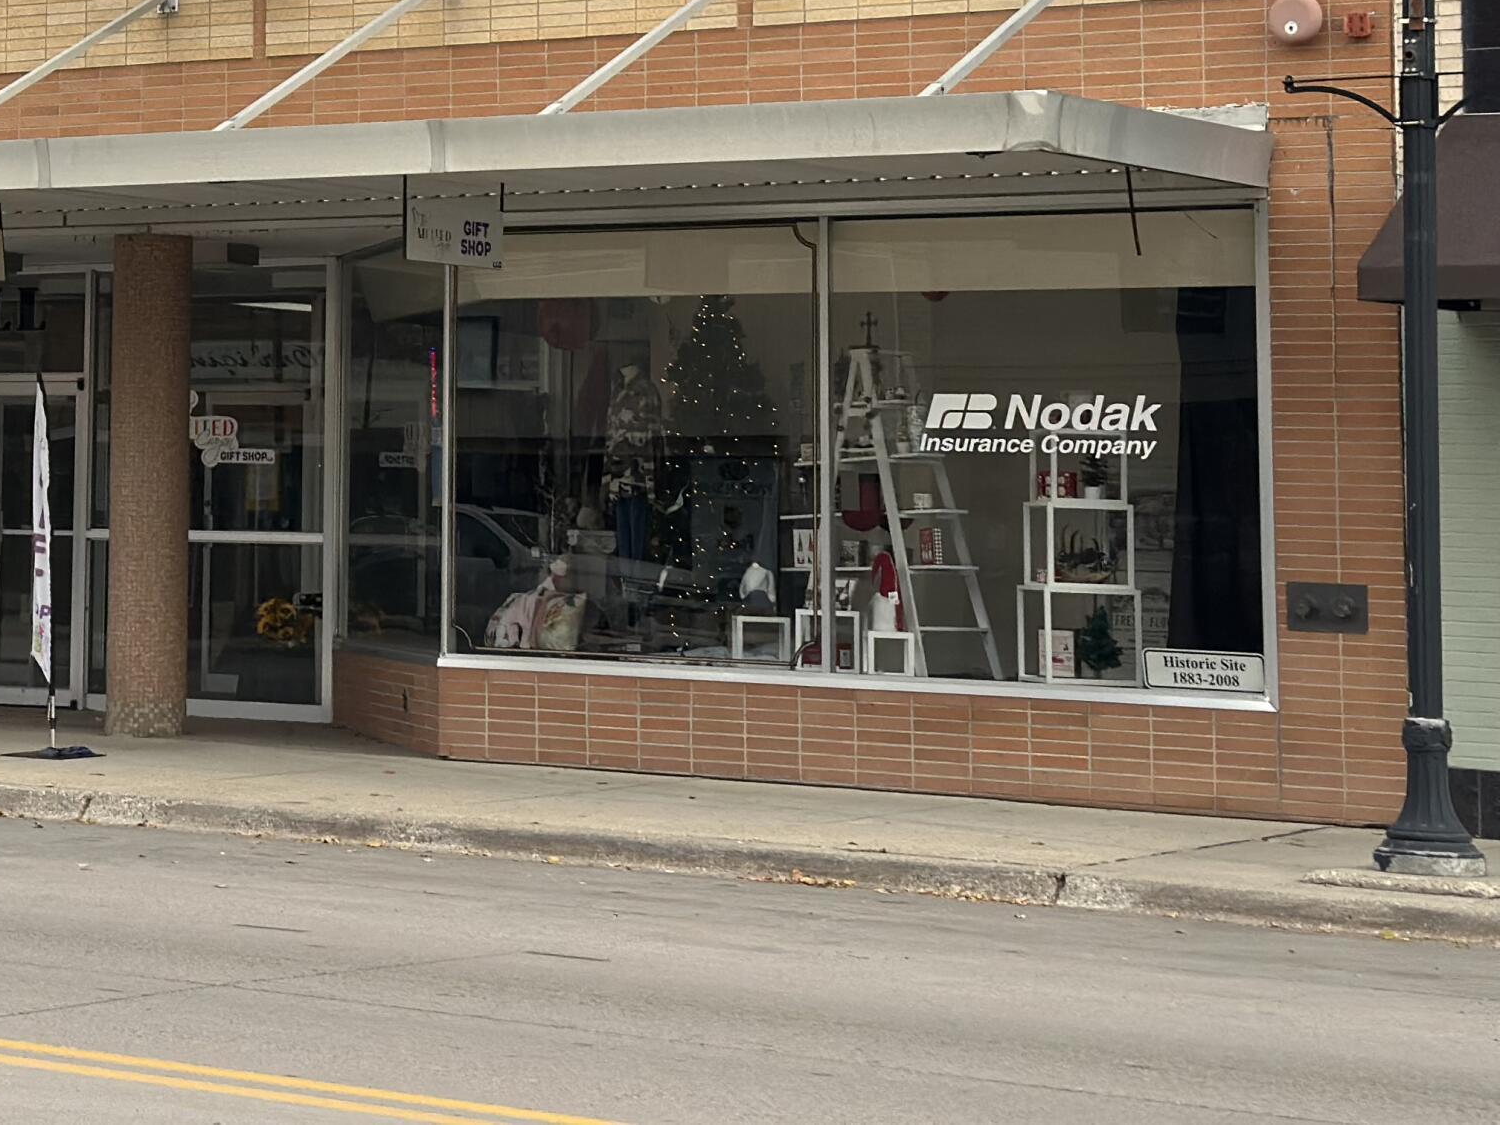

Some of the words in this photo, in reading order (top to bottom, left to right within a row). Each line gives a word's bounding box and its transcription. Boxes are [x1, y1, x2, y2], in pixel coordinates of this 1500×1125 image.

[463, 220, 489, 239] GIFT
[460, 239, 492, 256] SHOP
[1004, 394, 1162, 431] Nodak
[919, 433, 1034, 453] Insurance
[1041, 434, 1157, 460] Company
[220, 451, 240, 461] GIFT
[242, 451, 267, 461] SHOP
[1163, 655, 1217, 671] Historic
[1220, 658, 1247, 672] Site
[1172, 671, 1241, 687] 1883-2008
